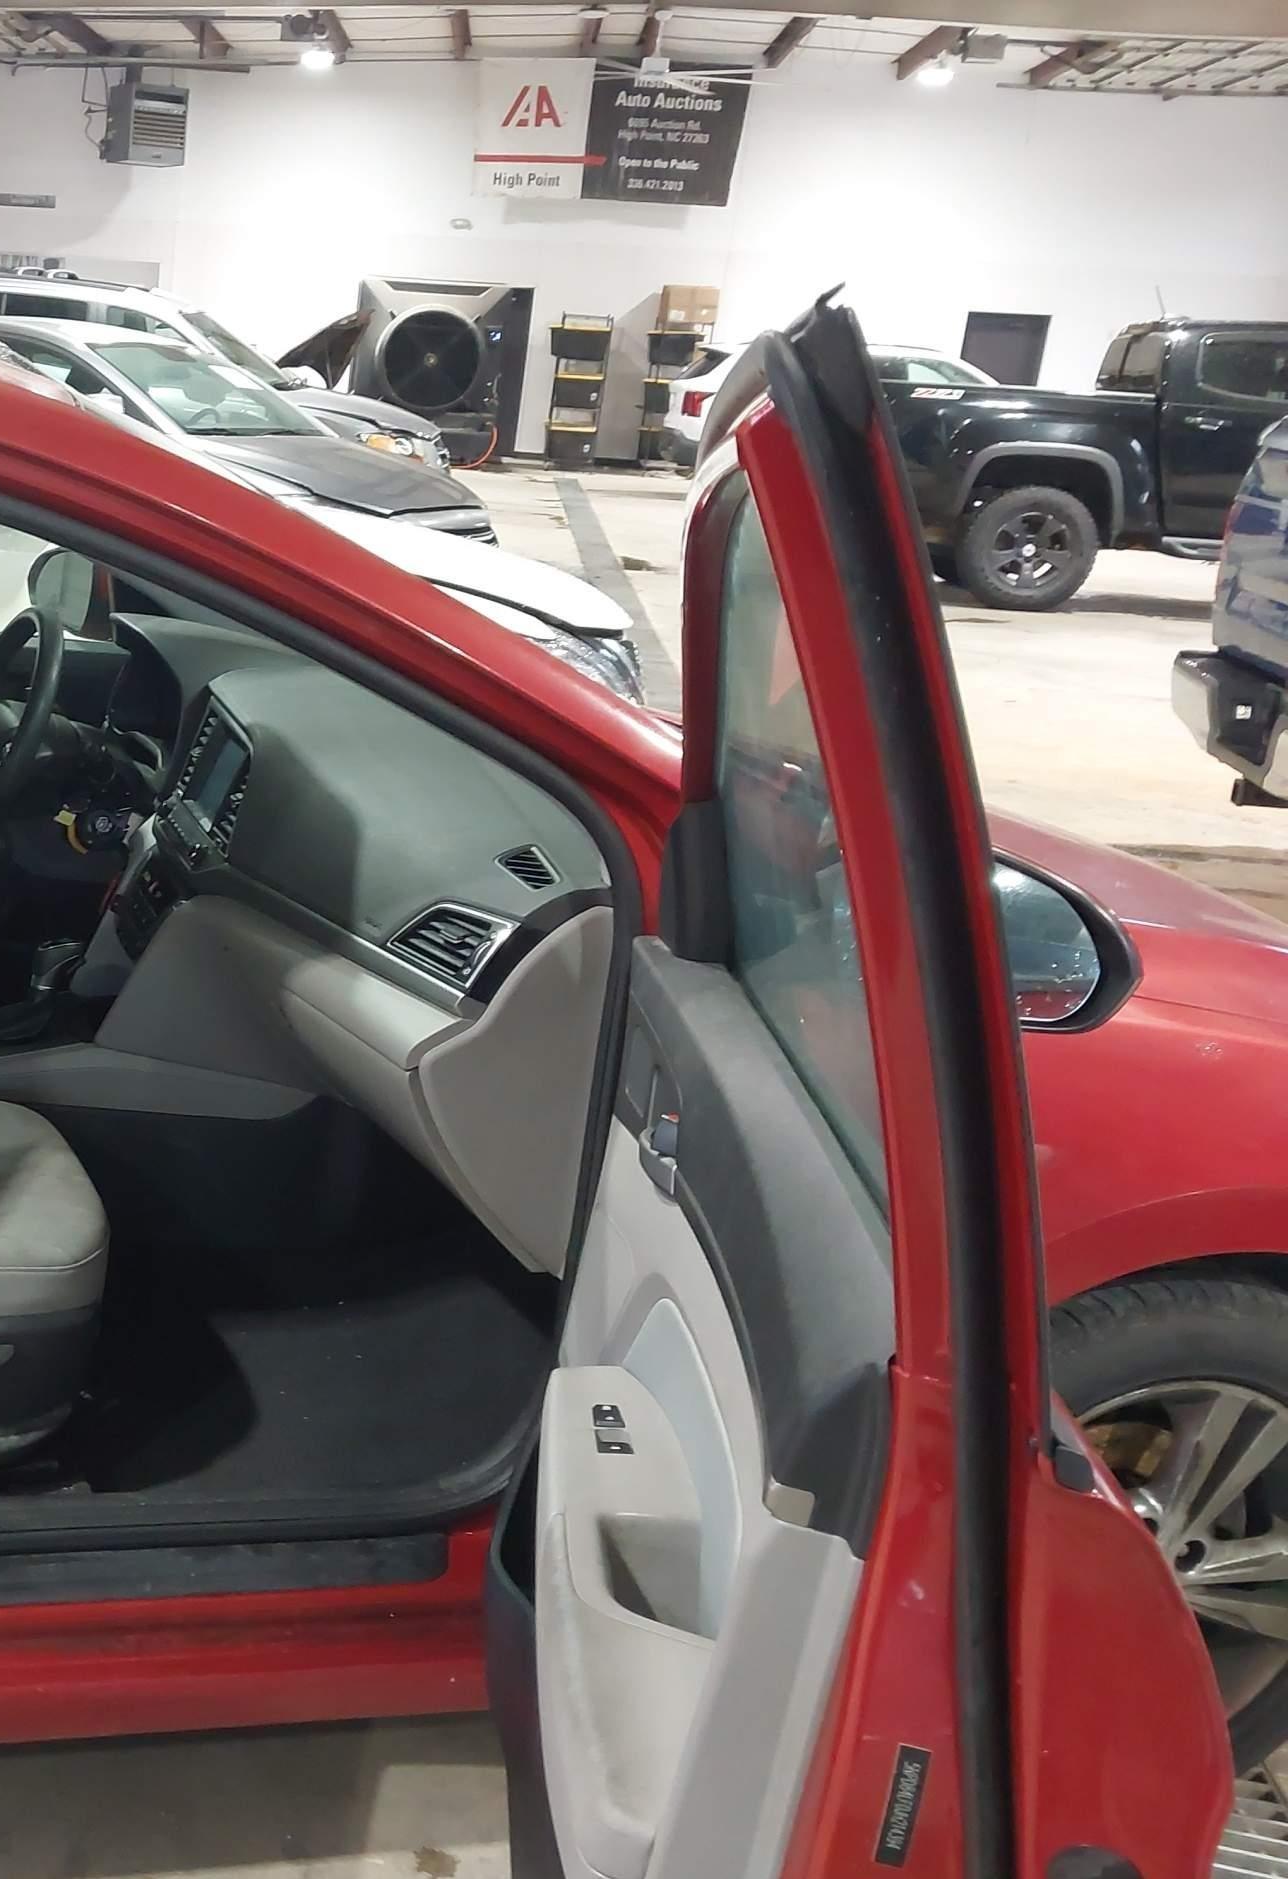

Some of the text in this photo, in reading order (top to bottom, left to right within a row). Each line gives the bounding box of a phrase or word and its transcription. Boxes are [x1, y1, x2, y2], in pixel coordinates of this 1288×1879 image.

[614, 91, 723, 112] Auto Auctions
[617, 129, 638, 142] High
[666, 132, 682, 143] NC
[618, 156, 700, 171] Open to the Public
[492, 172, 560, 187] High Point
